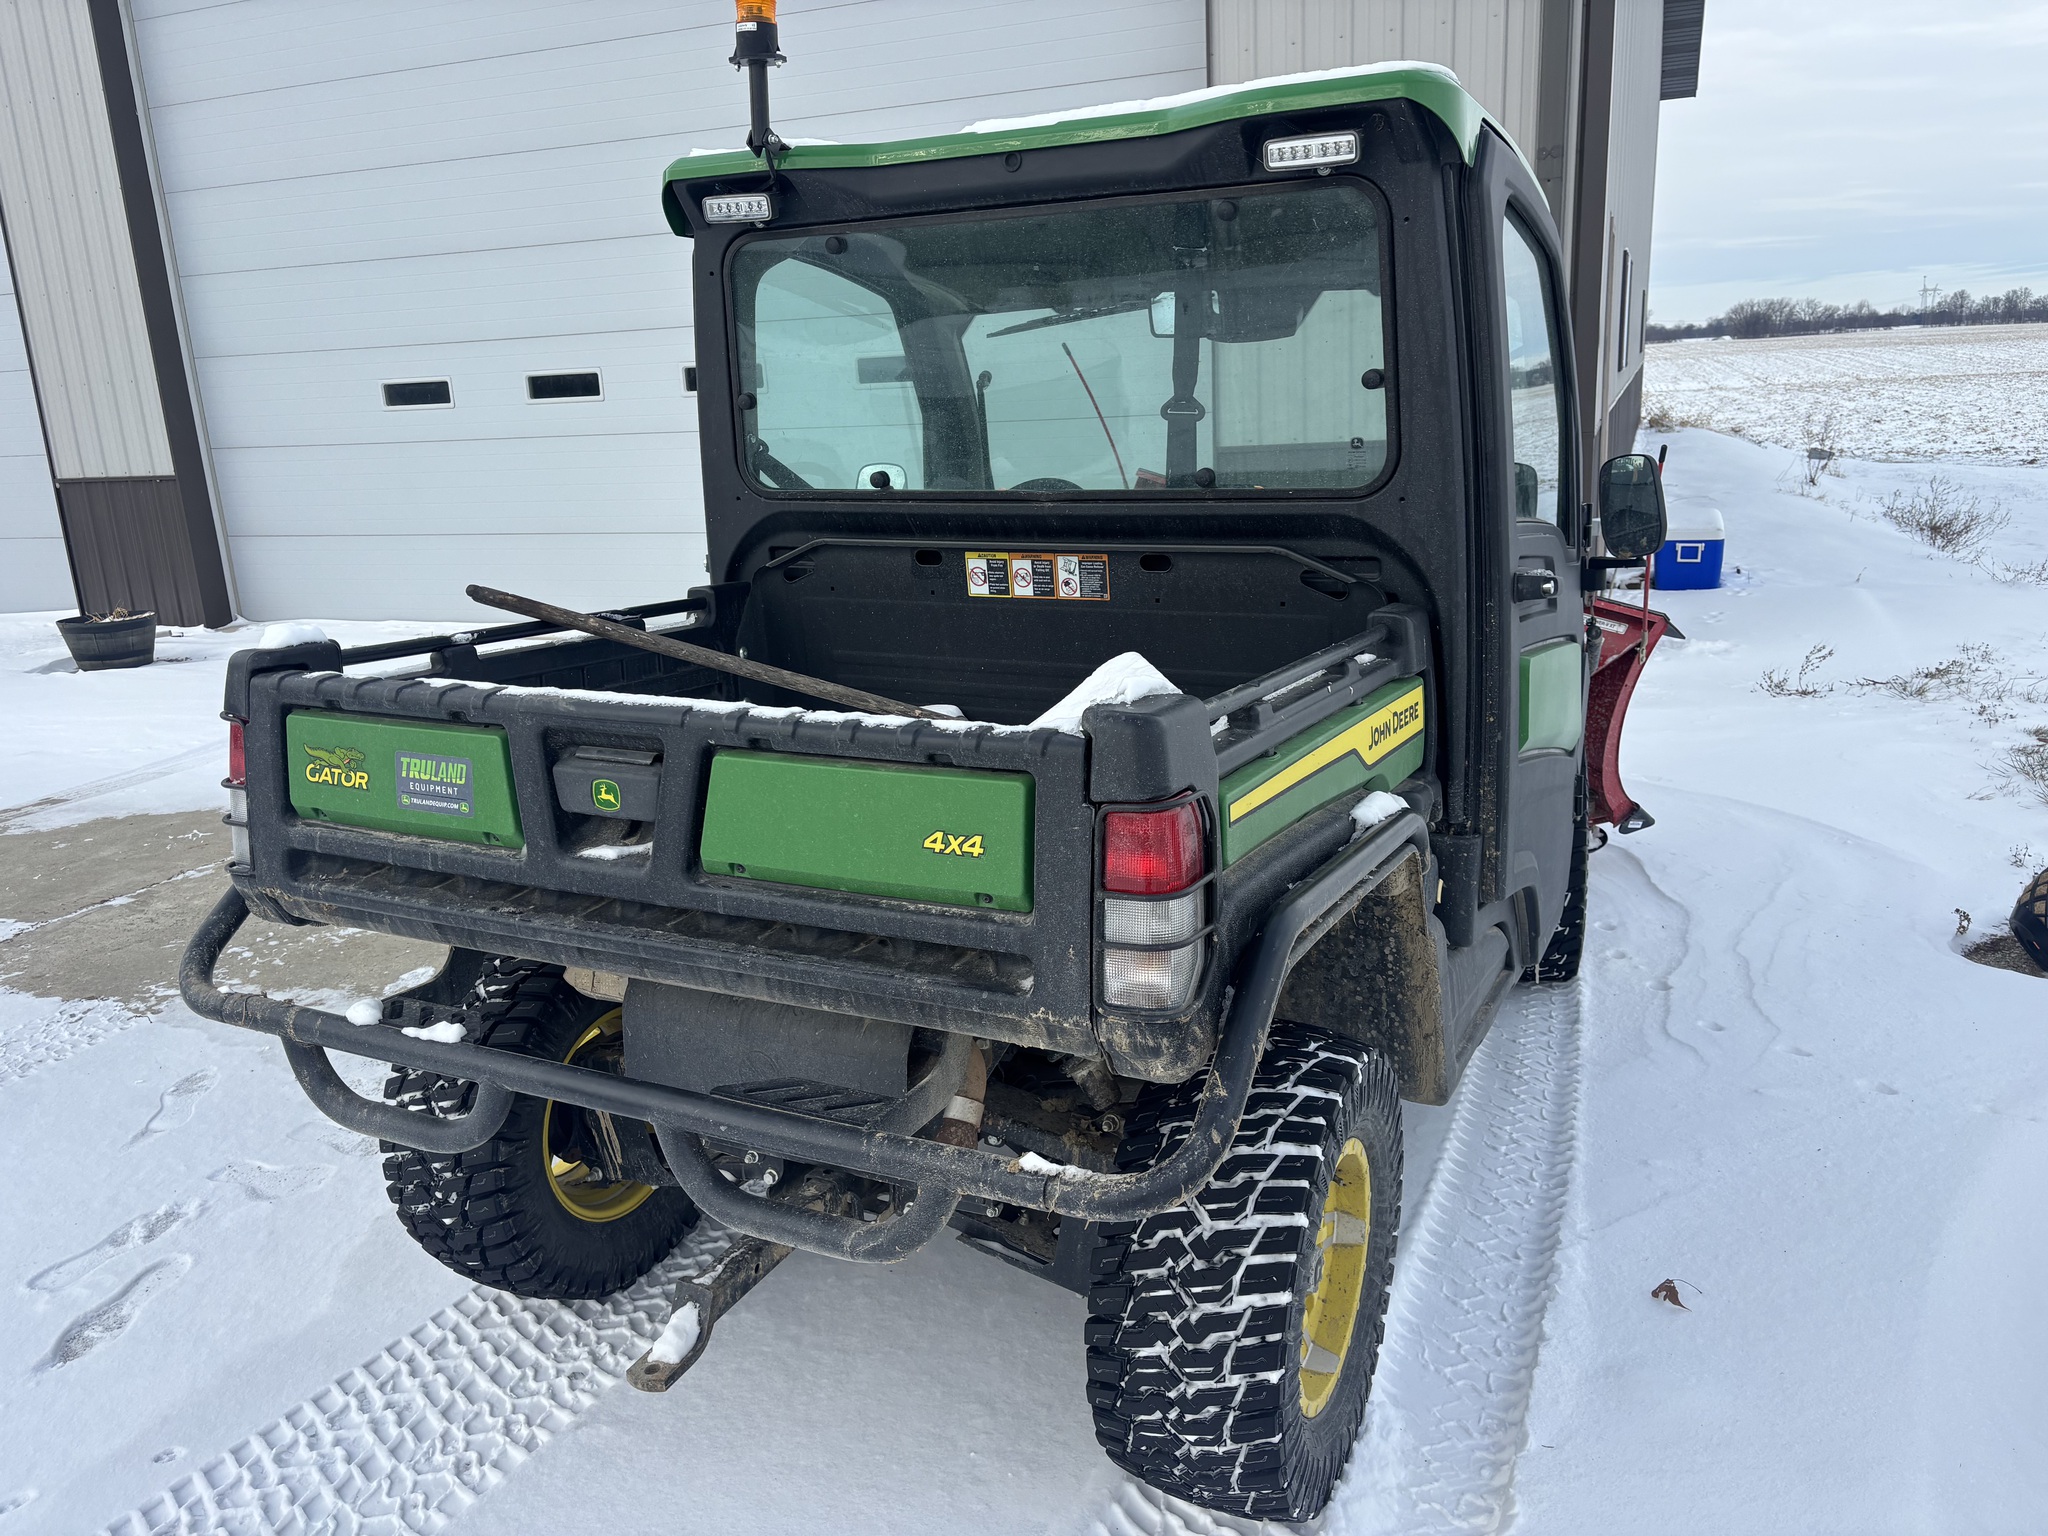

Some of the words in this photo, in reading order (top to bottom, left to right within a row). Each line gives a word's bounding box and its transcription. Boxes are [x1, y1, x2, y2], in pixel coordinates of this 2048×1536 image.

[1368, 718, 1391, 751] JOHN
[1392, 701, 1419, 734] DEERE
[305, 763, 369, 790] GATOR
[400, 757, 466, 785] TRULAND
[409, 781, 458, 795] EQUIPMENT
[410, 797, 459, 809] TRULANDEQUIP.COM
